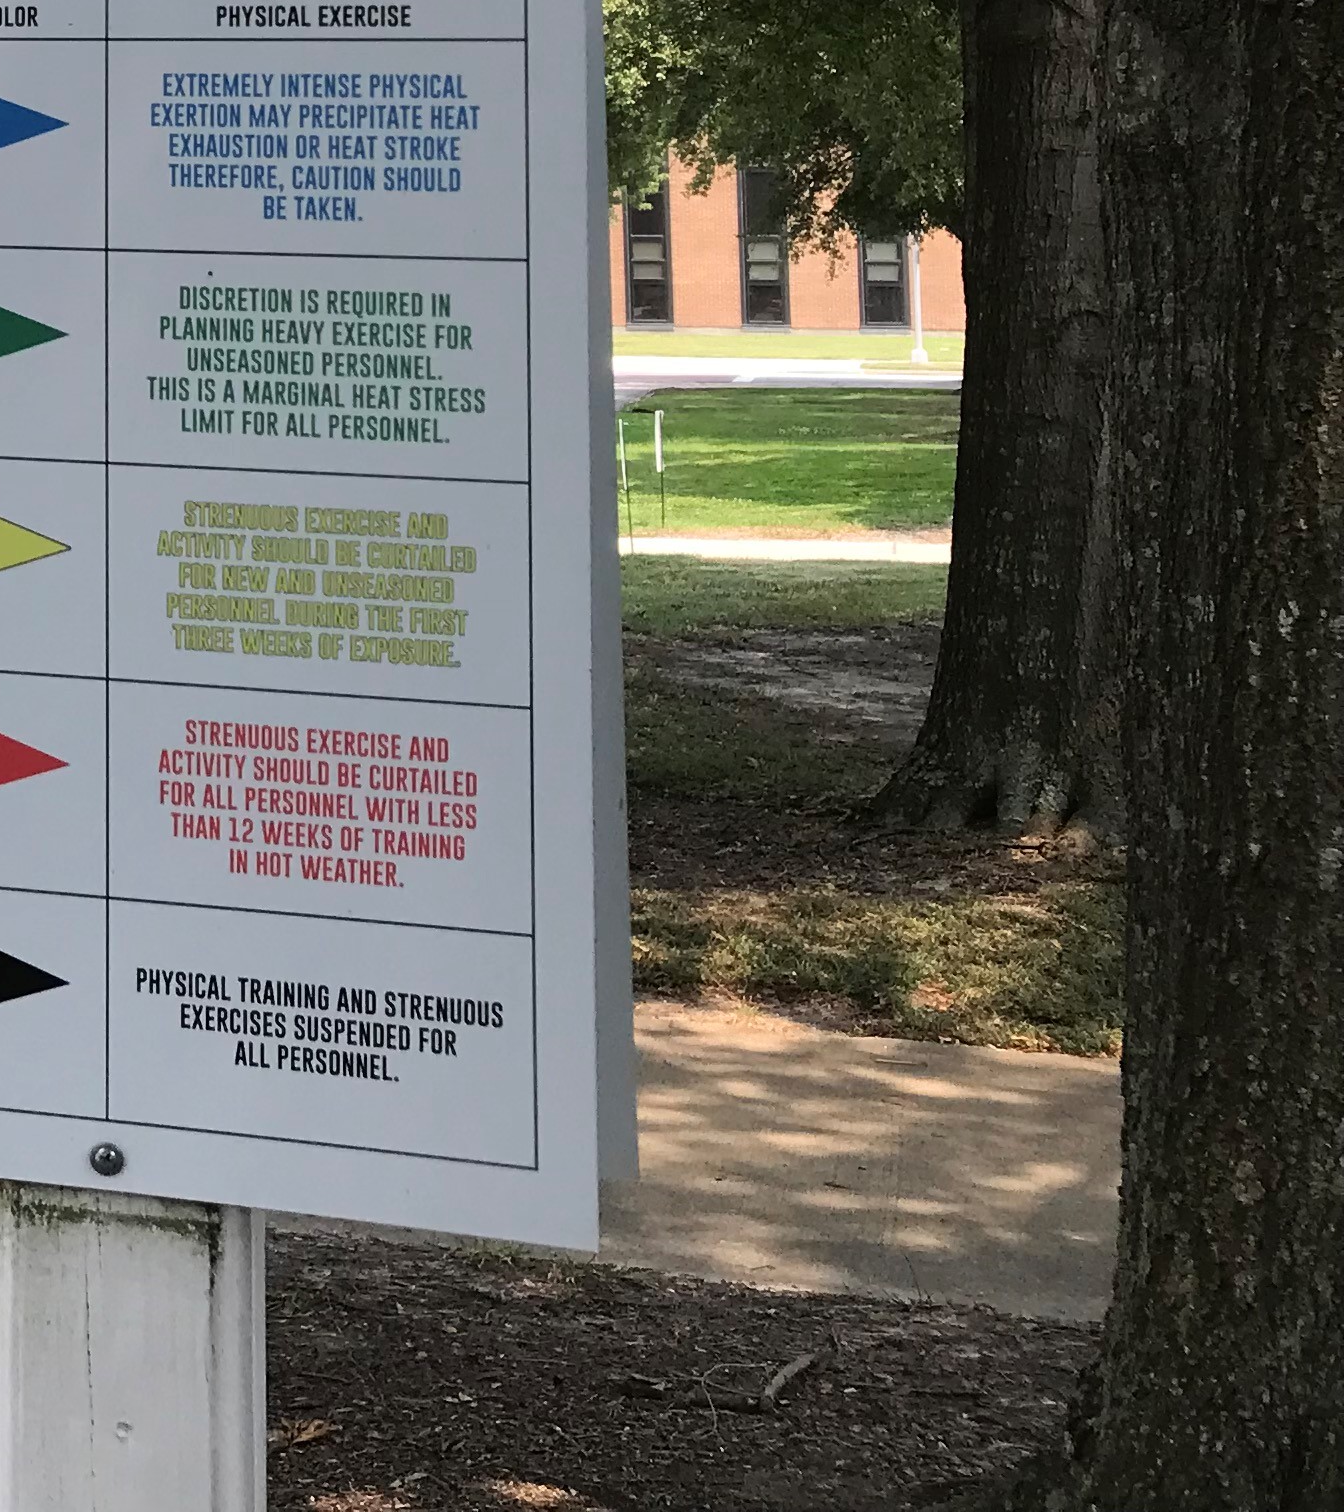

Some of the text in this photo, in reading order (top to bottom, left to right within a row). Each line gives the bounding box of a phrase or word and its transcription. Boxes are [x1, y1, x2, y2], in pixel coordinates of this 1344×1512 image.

[216, 4, 411, 28] PHYSICAL EXERCISE
[163, 73, 468, 99] EXTREMELY INTENSE PHYSICAL
[151, 103, 480, 131] EXERTION MAY PRECIPITATE HEAT
[169, 133, 461, 161] EXHAUSTION OR HEAT STROKE
[168, 163, 461, 193] THEREFORE, CAUTION SHOULD
[263, 195, 363, 222] BE TAKEN.
[180, 286, 450, 319] DISCRETION IS REQUIRED IN
[160, 316, 473, 350] PLANNING HEAVY EXERCISE FOR
[187, 347, 442, 380] UNSEASONED PERSONNEL.
[146, 376, 485, 414] THIS IS A MARGINAL HEAT STRESS
[181, 408, 450, 443] LIMIT FOR ALL PERSONNEL.
[184, 501, 448, 540] STRENUOUS EXERCISE AND
[157, 530, 477, 573] ACTIVITY SHOULD BE CURTAILED
[179, 562, 454, 604] FOR NEW AND UNSEASONED
[286, 600, 359, 630] DURING
[365, 604, 403, 633] THE
[410, 607, 468, 636] FIRST
[172, 624, 461, 668] THREE WEEKS OF EXPOSURE.
[186, 719, 449, 763] STRENUOUS EXERCISE AND
[159, 749, 478, 797] ACTIVITY SHOULD BE CURTAILED
[160, 780, 477, 830] FOR ALL PERSONNEL WITH LESS
[171, 812, 466, 861] THAN 12 WEEKS OF TRAINING
[230, 848, 404, 888] IN HOT WEATHER.
[136, 967, 504, 1029] PHYSICAL TRAINING AND STRENUOUS
[181, 1002, 457, 1057] EXERCISES SUSPENDED FOR
[234, 1040, 399, 1082] ALL PERSONNEL.
